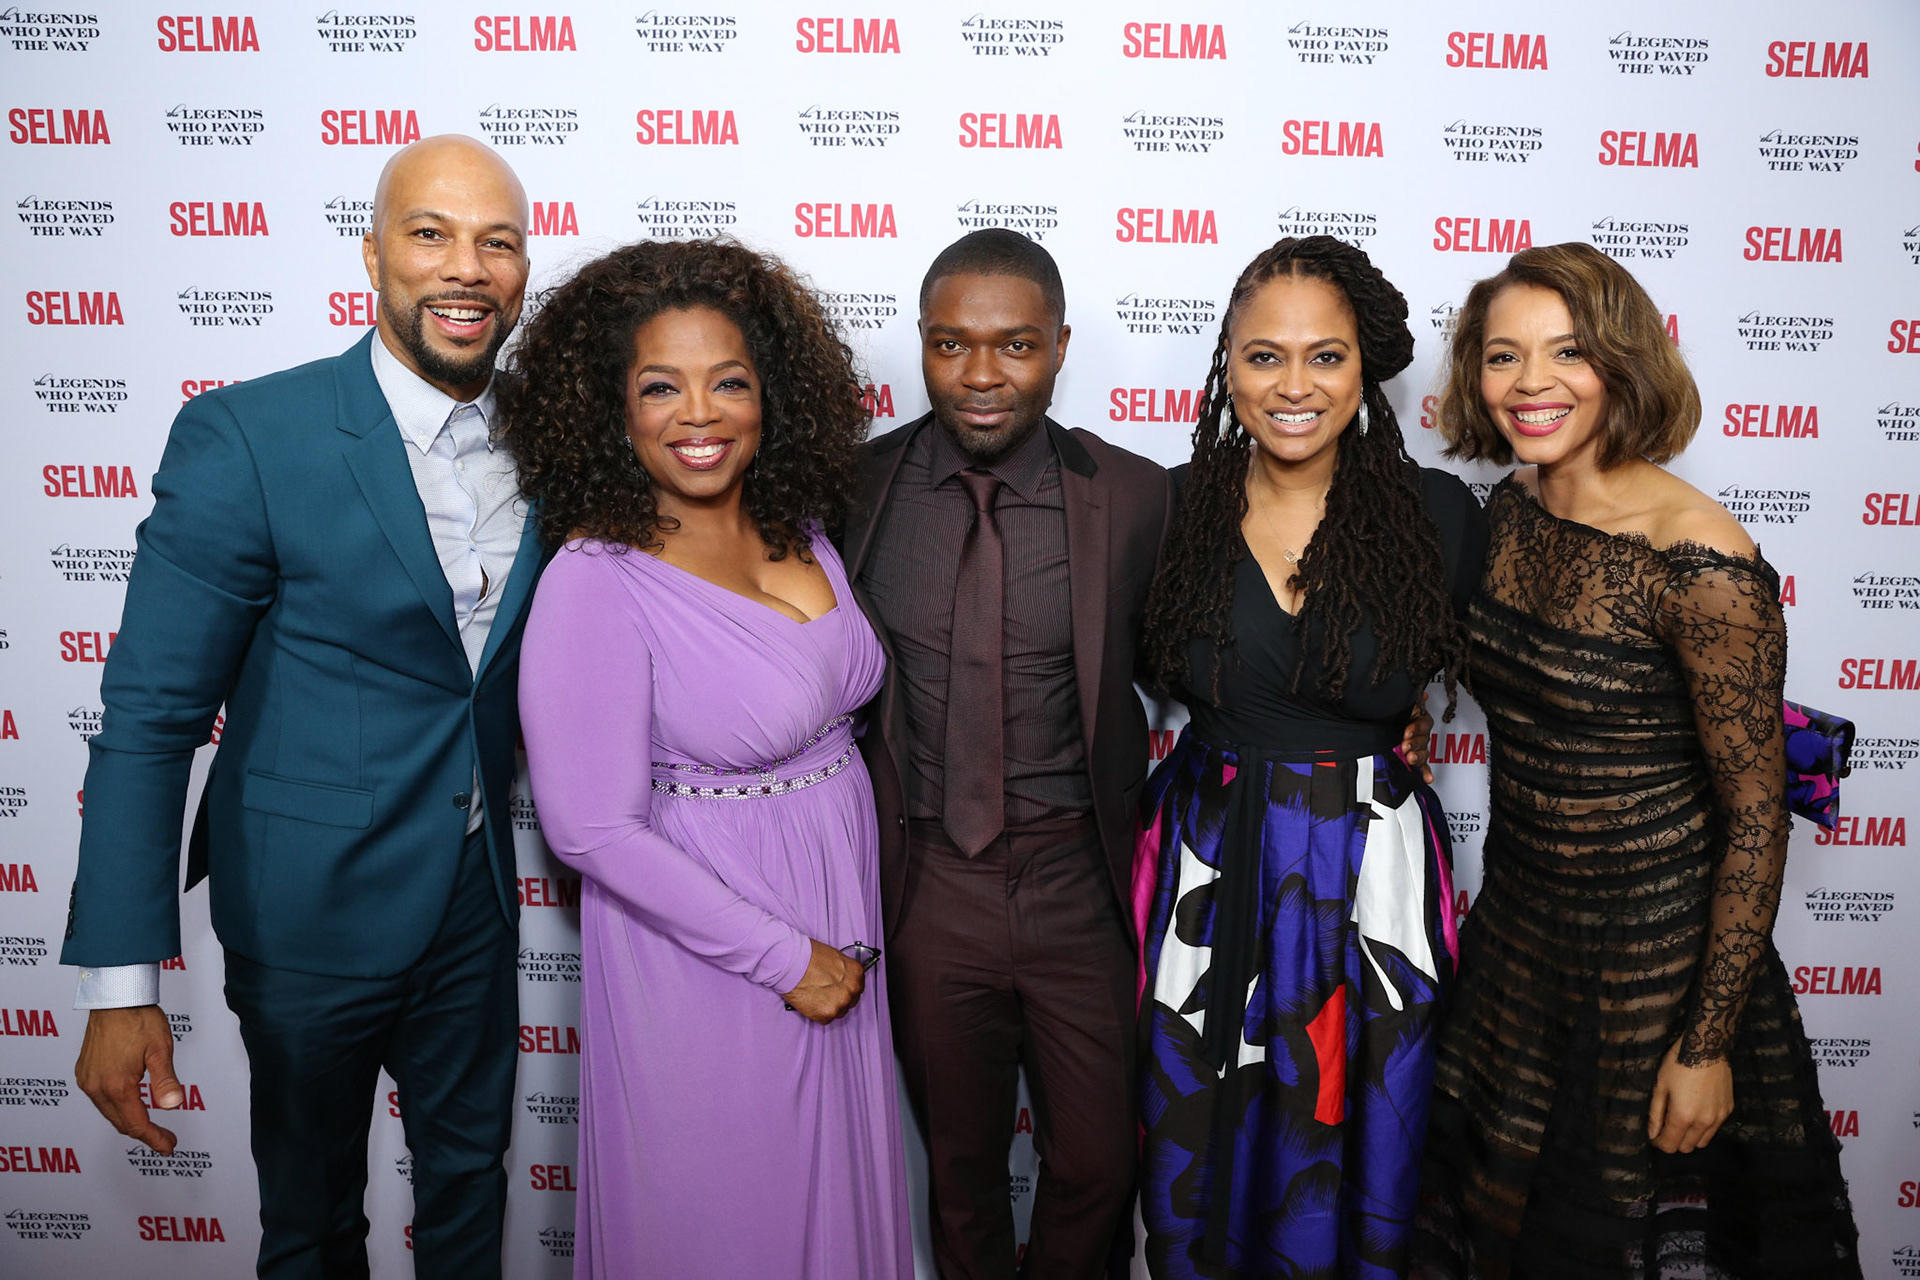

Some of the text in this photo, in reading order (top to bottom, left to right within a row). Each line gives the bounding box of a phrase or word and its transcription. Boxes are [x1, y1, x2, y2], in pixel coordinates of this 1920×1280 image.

[14, 12, 98, 24] LEGENDS
[334, 15, 415, 25] LEGENDS
[978, 18, 1063, 30] LEGENDS
[0, 26, 100, 38] WHO PAVED
[157, 15, 259, 51] SELMA
[318, 29, 416, 39] WHO PAVED
[474, 16, 575, 51] SELMA
[796, 17, 899, 53] SELMA
[962, 32, 1064, 44] WHO PAVED
[1123, 22, 1225, 59] SELMA
[1625, 36, 1709, 49] LEGENDS
[11, 40, 89, 51] THE WAY
[329, 42, 405, 51] THE WAY
[972, 45, 1051, 56] THE WAY
[1446, 31, 1547, 69] SELMA
[1608, 50, 1708, 63] WHO PAVED
[1765, 41, 1868, 77] SELMA
[1617, 63, 1695, 74] THE WAY
[182, 109, 262, 119] LEGENDS
[815, 110, 899, 120] LEGENDS
[8, 108, 110, 144] SELMA
[168, 122, 264, 132] WHO PAVED
[321, 110, 421, 146] SELMA
[637, 109, 738, 144] SELMA
[799, 123, 900, 134] WHO PAVED
[959, 113, 1061, 148] SELMA
[1460, 124, 1542, 137] LEGENDS
[178, 135, 253, 144] THE WAY
[809, 136, 888, 146] THE WAY
[1282, 120, 1383, 156] SELMA
[1776, 134, 1859, 146] LEGENDS
[1444, 138, 1542, 151] WHO PAVED
[1598, 130, 1697, 167] SELMA
[1453, 151, 1530, 162] THE WAY
[1758, 148, 1858, 159] WHO PAVED
[1766, 161, 1844, 171] THE WAY
[33, 200, 112, 210] LEGENDS
[974, 204, 1057, 215] LEGENDS
[19, 213, 114, 224] WHO PAVED
[169, 201, 268, 236] SELMA
[327, 214, 366, 223] WHO
[795, 203, 896, 237] SELMA
[958, 217, 1058, 228] WHO PAVED
[30, 226, 104, 236] THE WAY
[338, 227, 372, 235] THE
[1116, 208, 1217, 243] SELMA
[1608, 221, 1689, 233] LEGENDS
[1433, 216, 1533, 253] SELMA
[1591, 234, 1688, 247] WHO PAVED
[1743, 226, 1841, 262] SELMA
[1600, 247, 1676, 258] THE WAY
[194, 291, 271, 300] LEGENDS
[26, 291, 123, 324] SELMA
[179, 304, 273, 314] WHO PAVED
[329, 292, 376, 326] SEL
[1133, 298, 1215, 309] LEGENDS
[843, 307, 897, 317] PAVED
[1116, 310, 1215, 322] WHO PAVED
[190, 316, 262, 325] THE WAY
[849, 320, 885, 329] WAY
[1754, 315, 1834, 327] LEGENDS
[1126, 323, 1203, 334] THE WAY
[1737, 328, 1833, 340] WHO PAVED
[1745, 341, 1820, 351] THE WAY
[49, 378, 126, 388] LEGENDS
[36, 391, 128, 401] WHO PAVED
[46, 403, 118, 412] THE WAY
[1723, 403, 1818, 438] SELMA
[1876, 419, 1916, 428] WHO
[1884, 431, 1920, 440] THE
[43, 464, 137, 497] SELMA
[1733, 489, 1811, 500] LEGENDS
[1758, 502, 1810, 512] PAVED
[1863, 492, 1920, 527] SEL
[1762, 514, 1797, 523] WAY
[52, 560, 88, 569] WHO
[62, 572, 95, 580] THE
[1852, 588, 1890, 597] WHO
[1859, 599, 1894, 608] THE
[60, 632, 116, 664] SEL
[1430, 733, 1486, 764] LMA
[1869, 750, 1918, 759] PAVED
[1873, 761, 1906, 769] WAY
[1815, 817, 1906, 848] SELMA
[1820, 891, 1894, 900] LEGENDS
[1804, 902, 1894, 911] WHO PAVED
[1848, 913, 1881, 921] WAY
[0, 947, 47, 956] PAVED
[7, 957, 39, 965] WAY
[516, 962, 551, 971] WHO
[526, 973, 557, 981] THE
[1793, 967, 1882, 996] SELMA
[520, 1026, 581, 1055] SELM
[1823, 1049, 1870, 1057] PAVED
[1827, 1059, 1858, 1067] WAY
[22, 1088, 69, 1097] PAVED
[29, 1098, 60, 1106] WAY
[527, 1105, 561, 1114] WHO
[536, 1116, 567, 1124] THE
[129, 1158, 212, 1168] WHO PAVED
[173, 1169, 204, 1177] WAY
[531, 1165, 577, 1192] SEL
[19, 1212, 88, 1220] LEGENDS
[137, 1215, 224, 1242] SELMA
